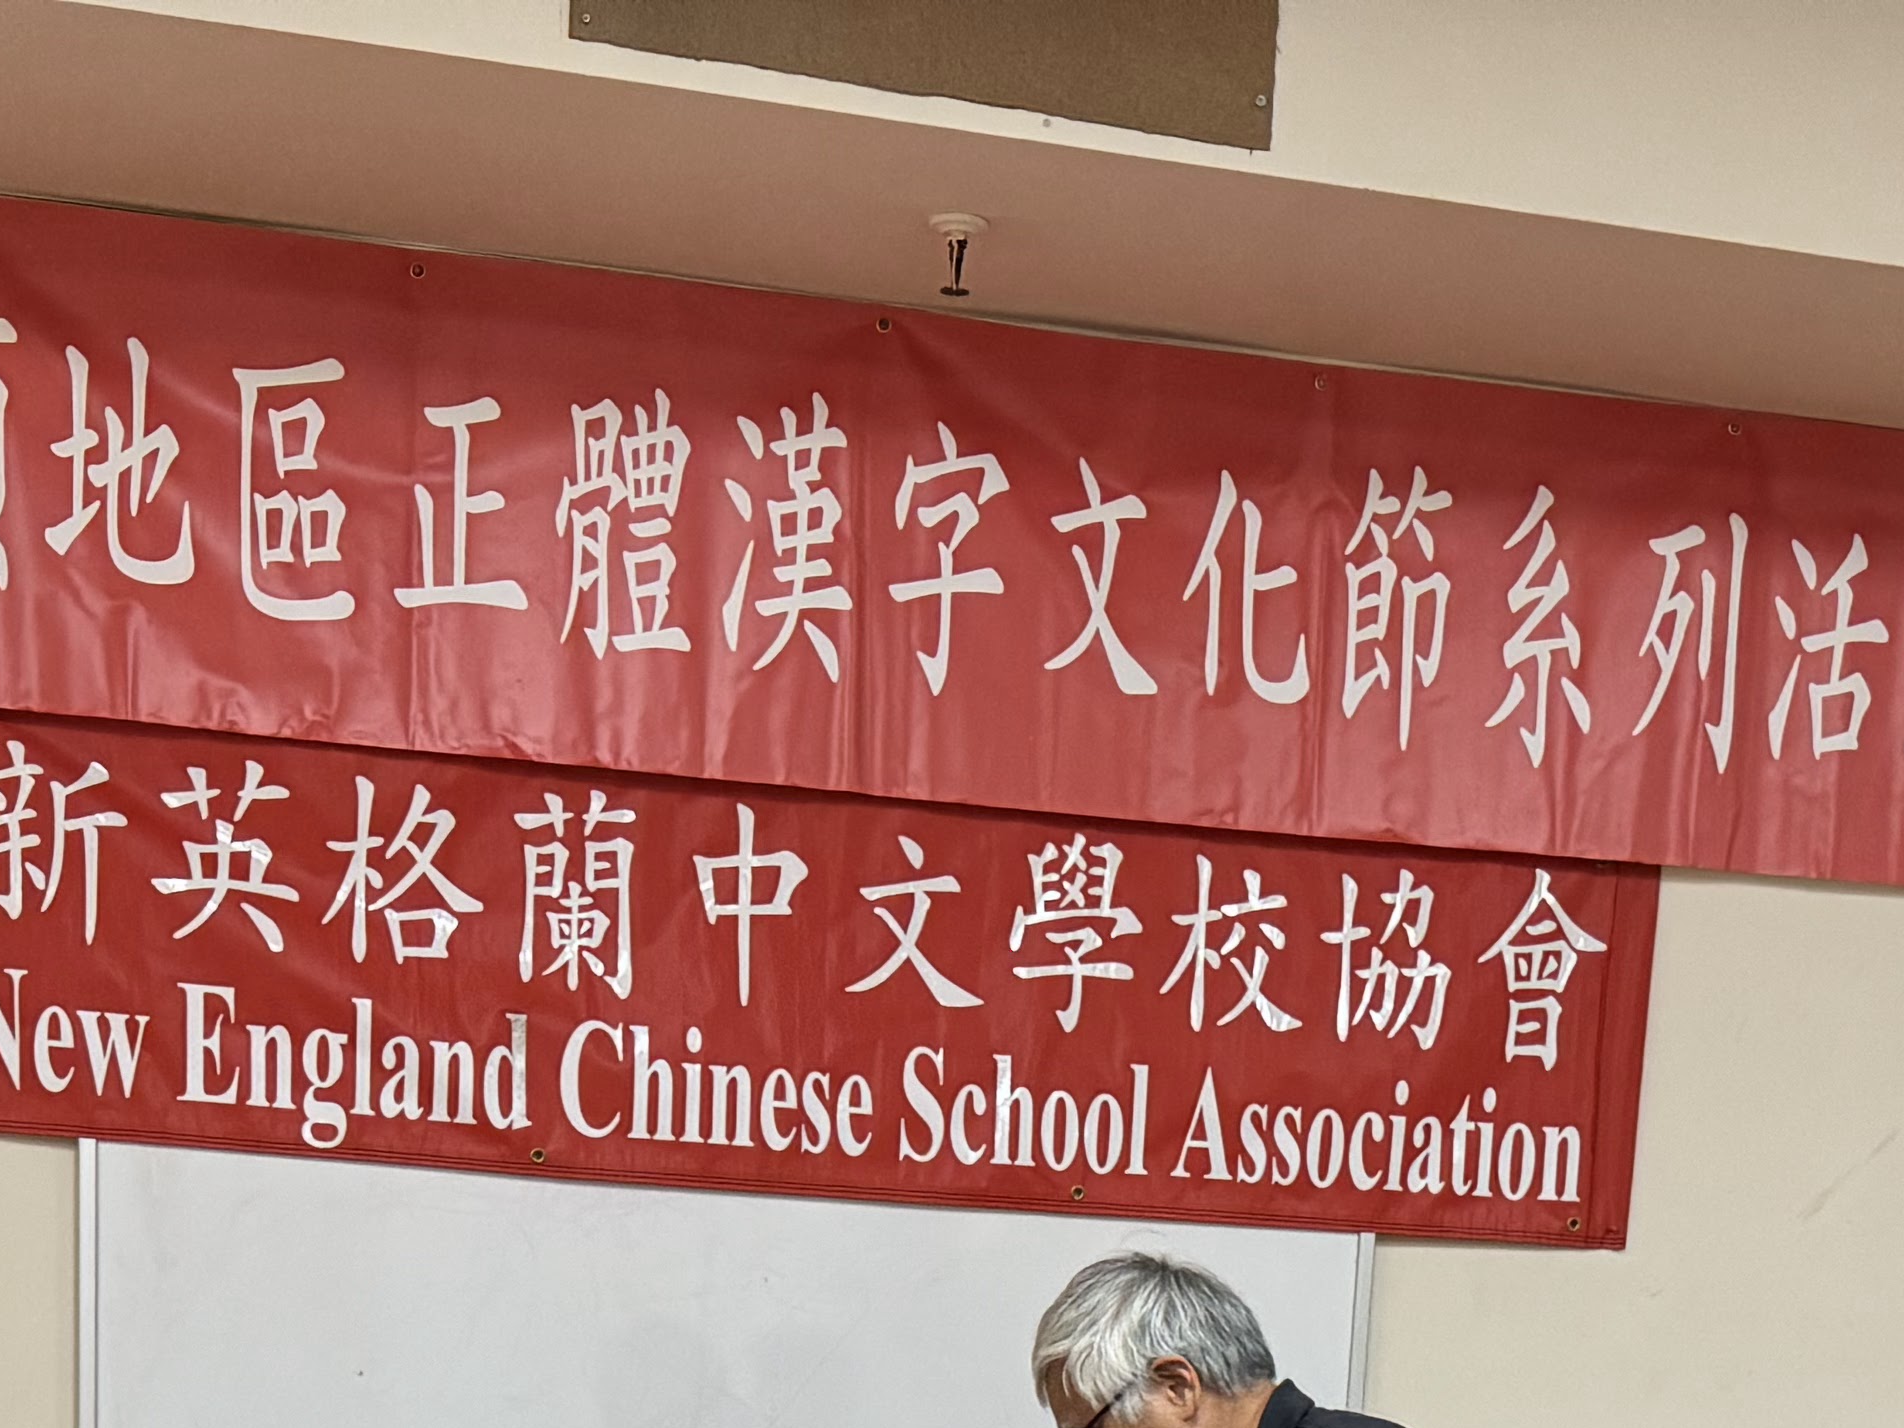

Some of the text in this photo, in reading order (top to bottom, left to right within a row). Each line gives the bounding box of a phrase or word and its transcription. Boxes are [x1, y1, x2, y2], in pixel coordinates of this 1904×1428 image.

[175, 981, 535, 1150] England
[558, 1017, 874, 1158] Chinese
[898, 1045, 1149, 1177] School
[1169, 1066, 1582, 1203] Association
